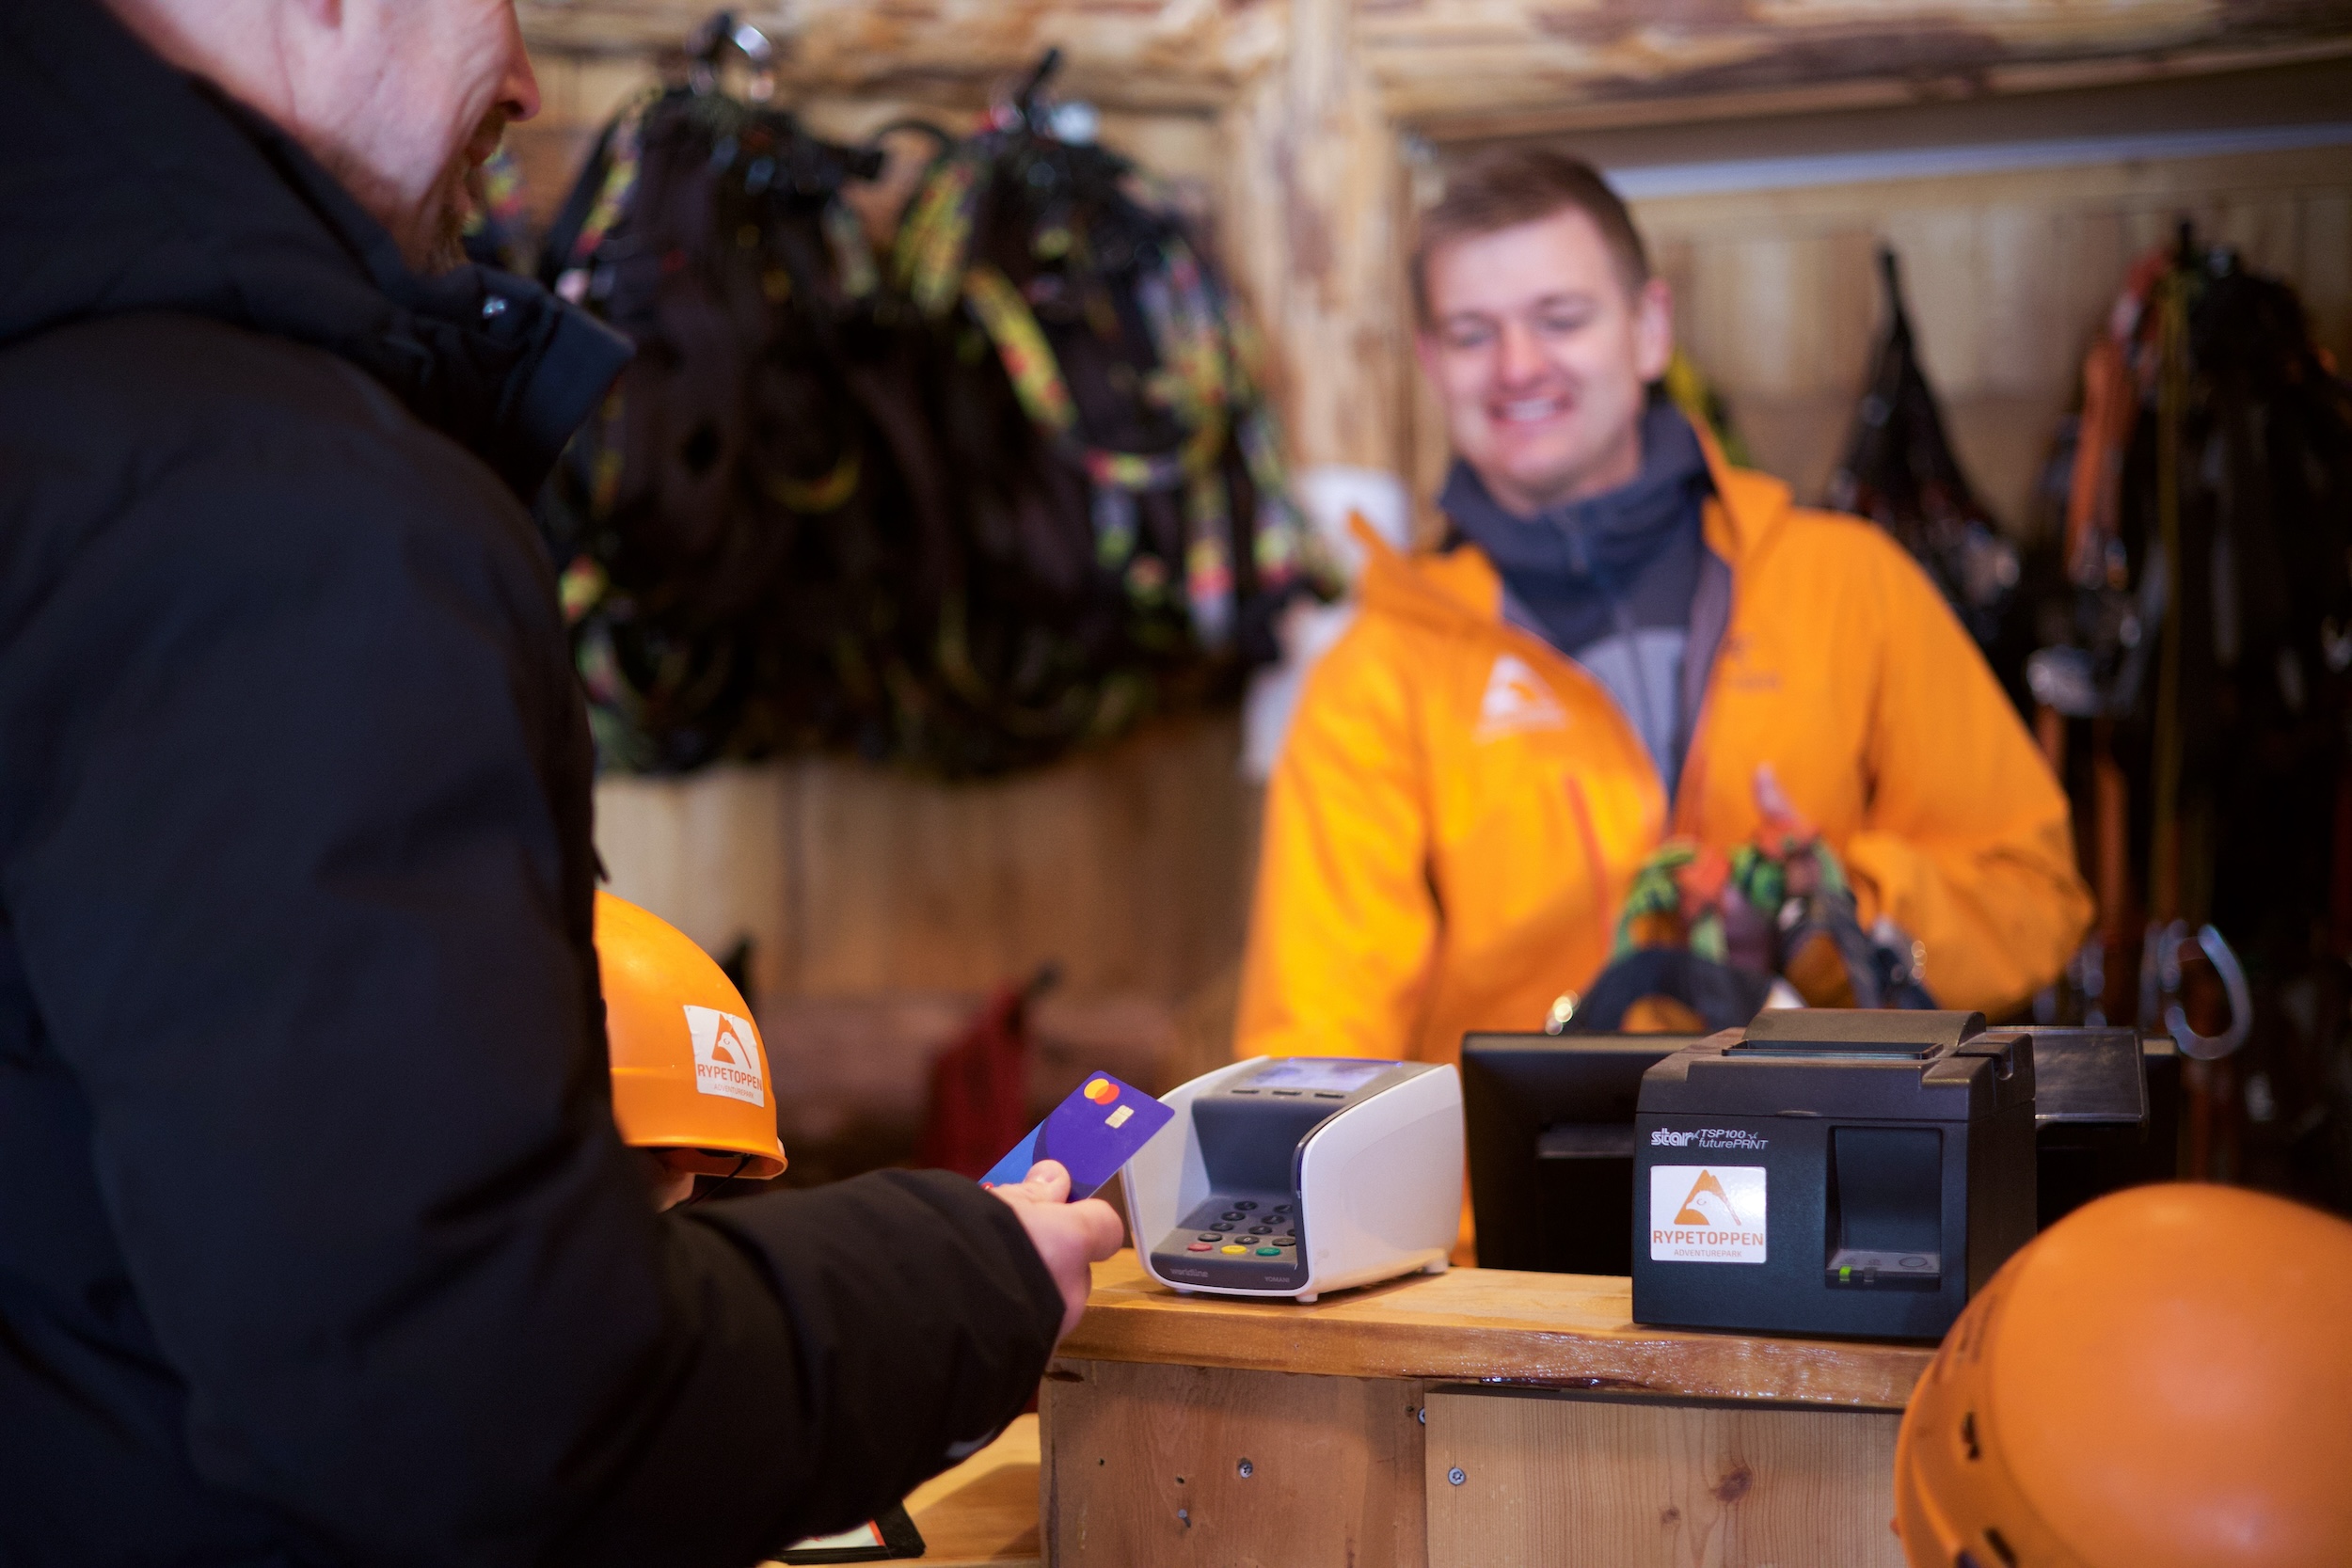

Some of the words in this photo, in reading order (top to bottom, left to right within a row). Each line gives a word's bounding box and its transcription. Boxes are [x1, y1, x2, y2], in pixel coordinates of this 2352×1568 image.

[697, 1064, 763, 1091] RYPETOPPEN
[1651, 1128, 1692, 1147] star
[1700, 1129, 1745, 1139] TSP100
[1698, 1139, 1769, 1149] futurePRNT
[1653, 1230, 1764, 1246] RYPETOPPEN
[1170, 1268, 1208, 1278] worldline
